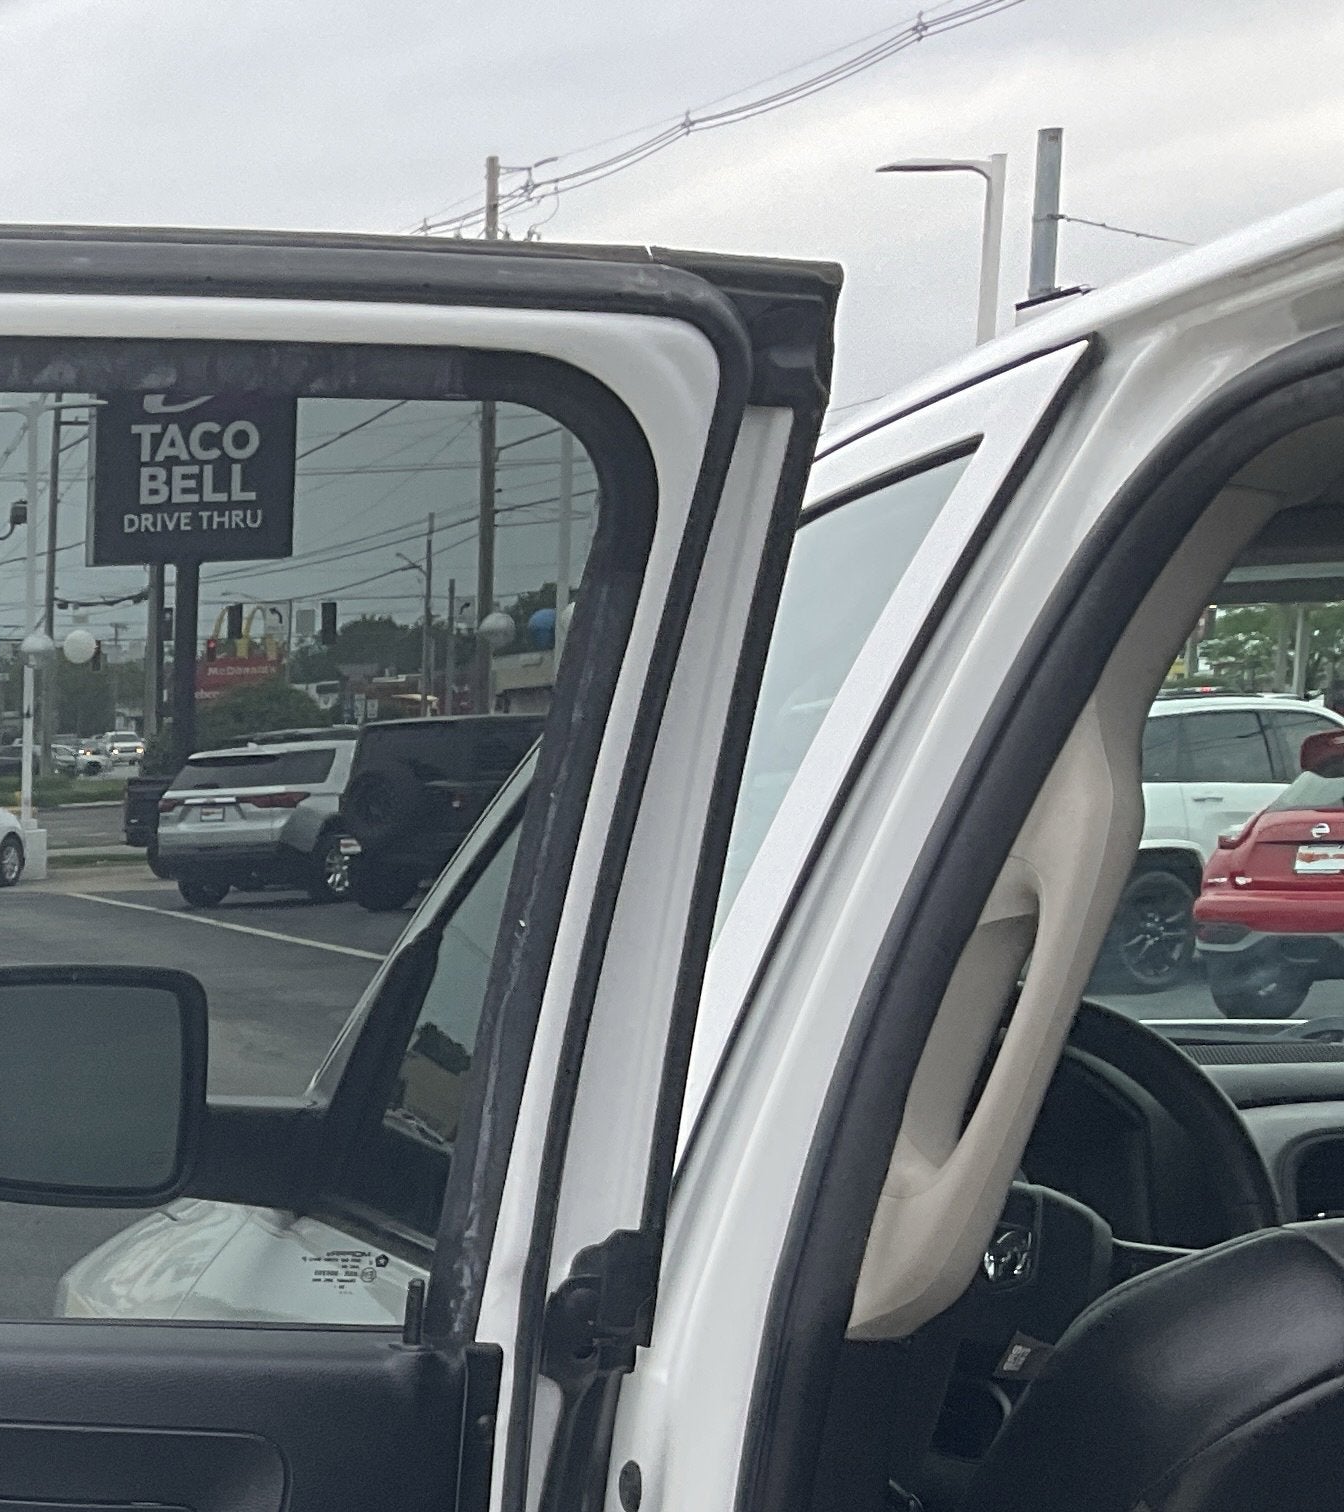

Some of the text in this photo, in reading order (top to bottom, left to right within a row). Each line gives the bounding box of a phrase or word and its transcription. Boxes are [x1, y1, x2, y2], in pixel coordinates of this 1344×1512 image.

[130, 420, 260, 462] TACO
[139, 463, 257, 505] BELL
[123, 509, 262, 533] DRIVE THRU
